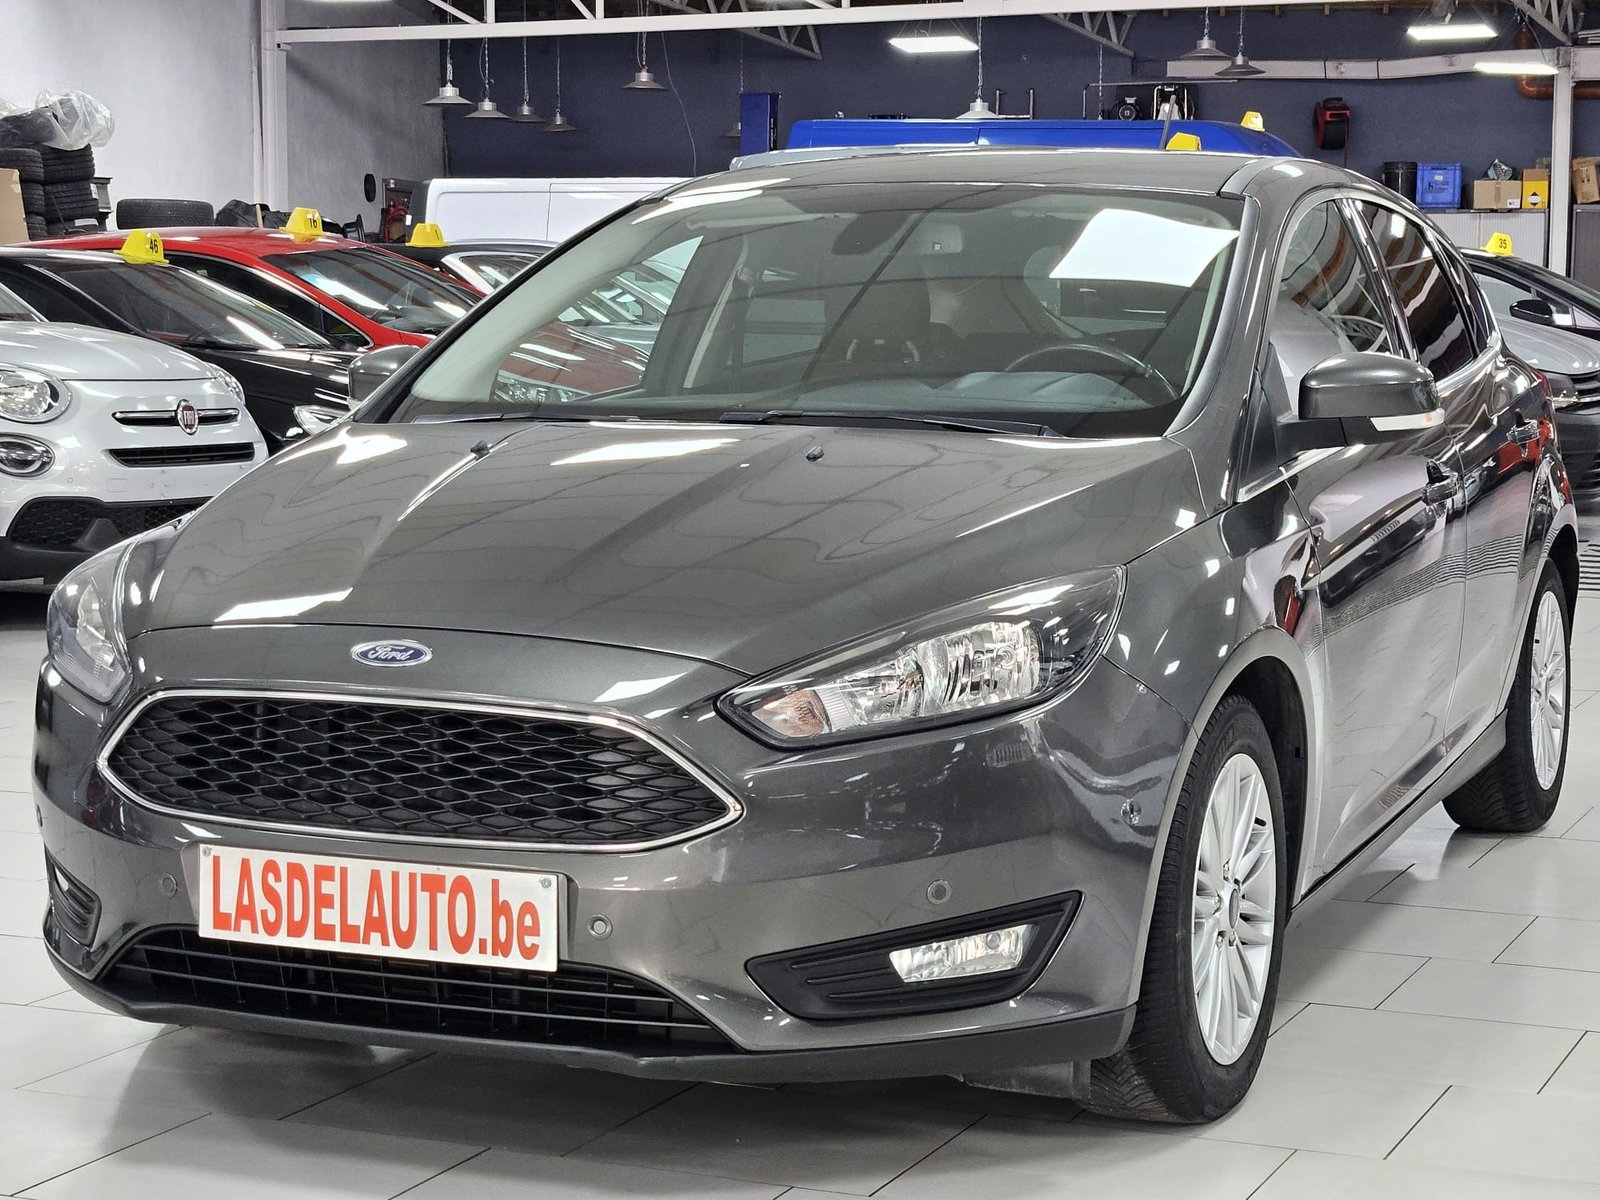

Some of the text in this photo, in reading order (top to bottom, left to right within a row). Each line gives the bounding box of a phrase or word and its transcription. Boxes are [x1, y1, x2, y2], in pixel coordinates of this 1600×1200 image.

[149, 238, 159, 254] 46
[1498, 238, 1507, 250] 35
[367, 643, 414, 661] Ford
[212, 855, 541, 960] LASDELAUTO.be
